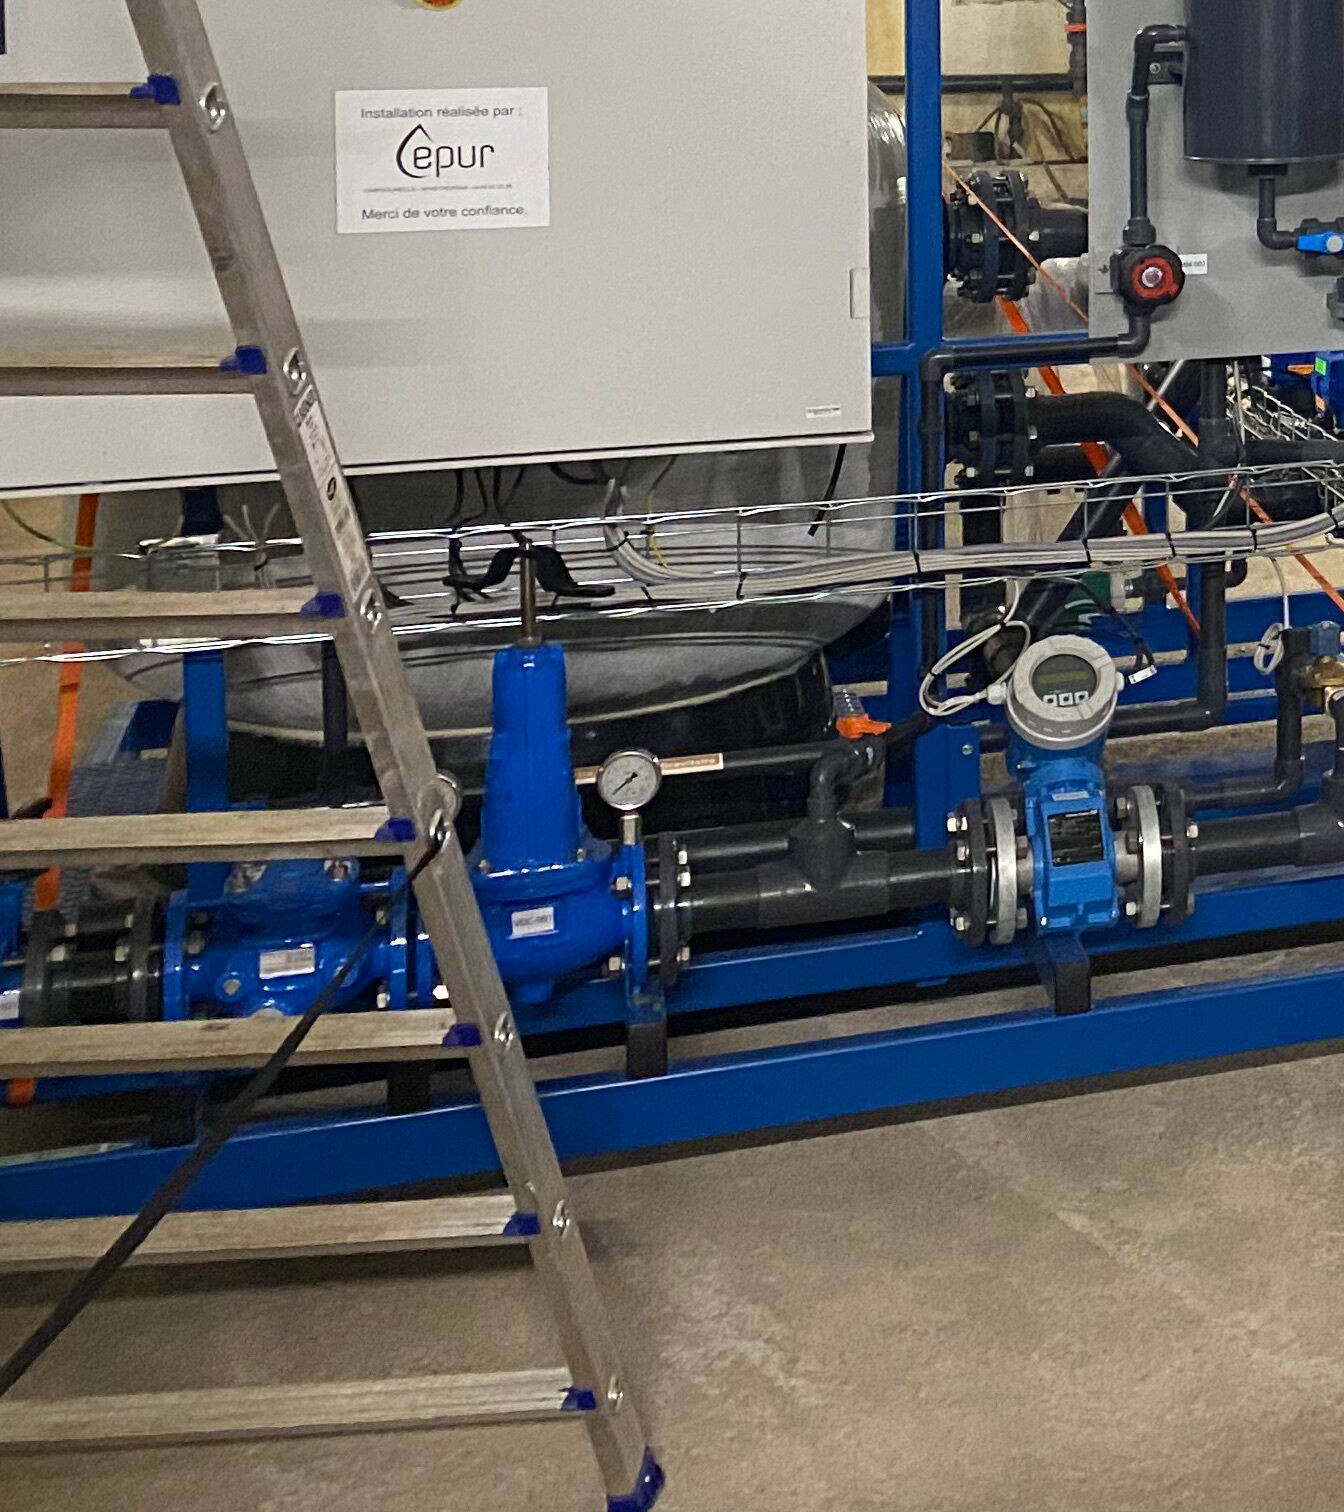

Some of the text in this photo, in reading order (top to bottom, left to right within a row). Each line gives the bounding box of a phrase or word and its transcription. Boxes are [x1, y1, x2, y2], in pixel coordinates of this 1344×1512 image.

[361, 107, 433, 119] Installation
[437, 106, 489, 118] réalisée
[493, 107, 515, 119] par
[413, 144, 495, 178] epur
[361, 204, 528, 220] Merci de votre confiance.
